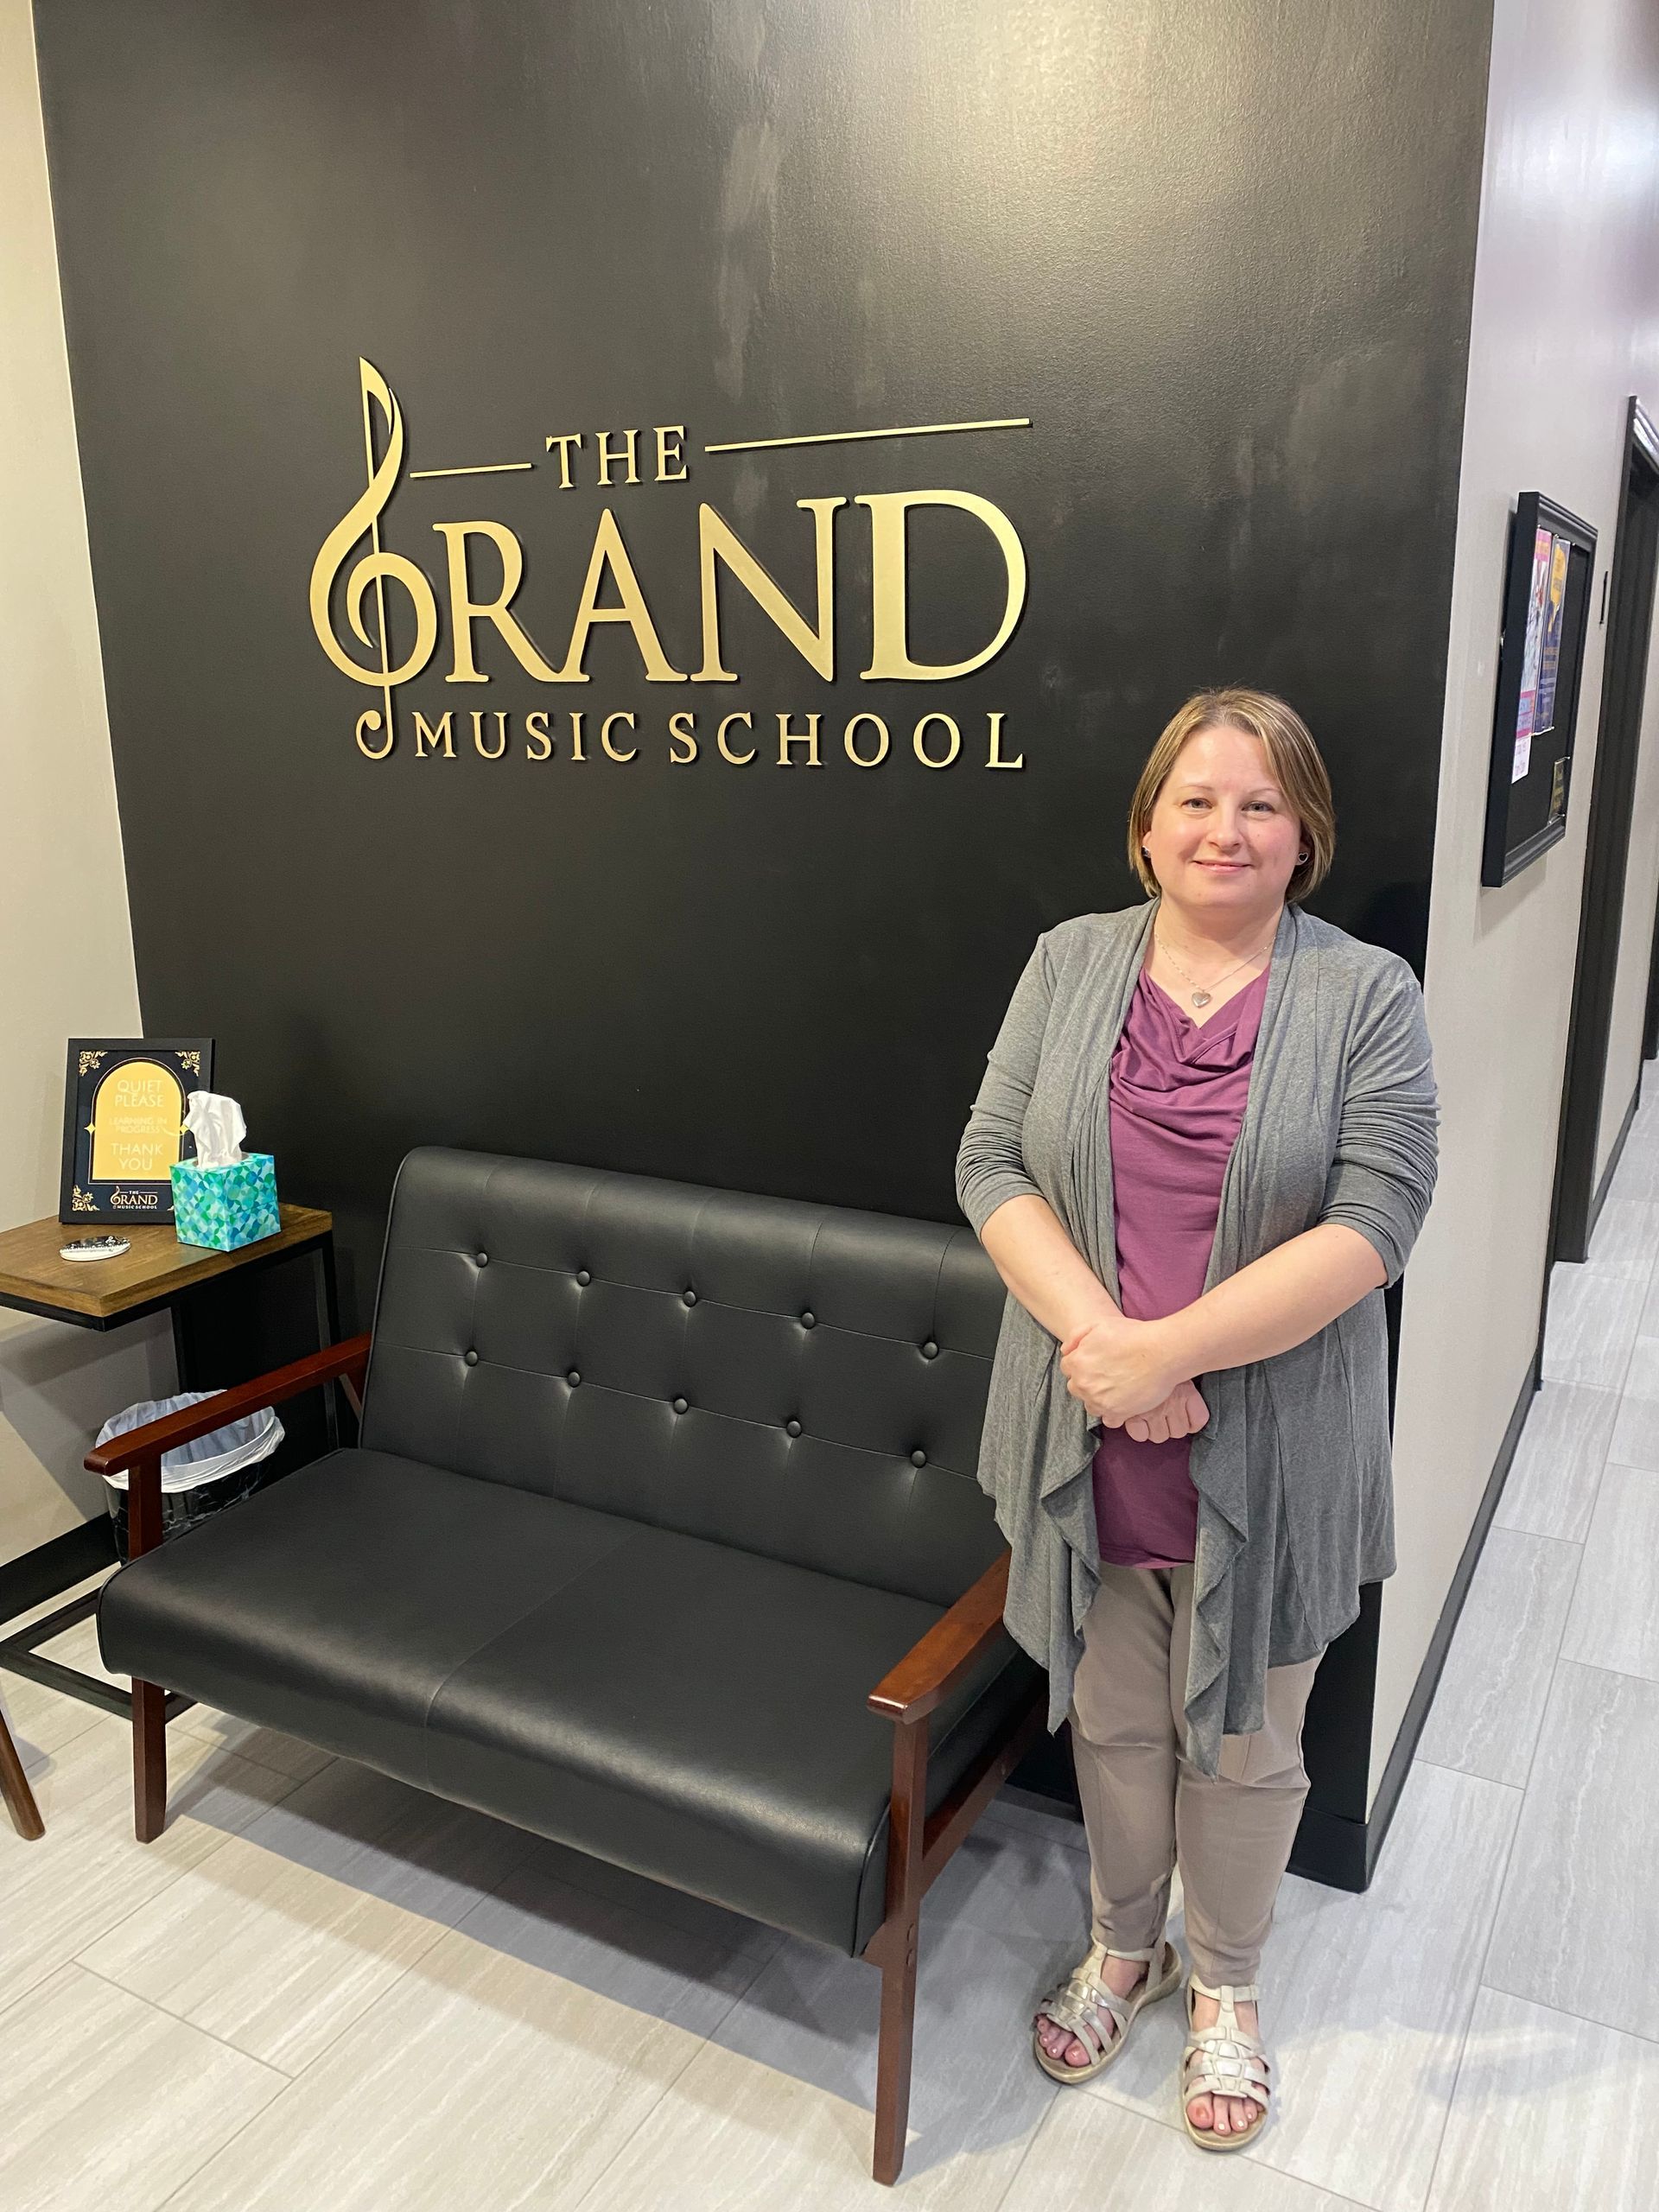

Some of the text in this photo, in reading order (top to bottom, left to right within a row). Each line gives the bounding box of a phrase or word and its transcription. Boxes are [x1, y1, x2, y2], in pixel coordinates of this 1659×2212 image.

[545, 424, 688, 489] THE
[309, 356, 1027, 760] GRAND
[411, 710, 1025, 770] MUSIC SCHOOL
[117, 1079, 162, 1094] QUIET
[114, 1095, 164, 1108] PLEASE
[111, 1142, 163, 1155] THANK
[118, 1158, 153, 1171] YOU
[110, 1185, 158, 1205] GRAND
